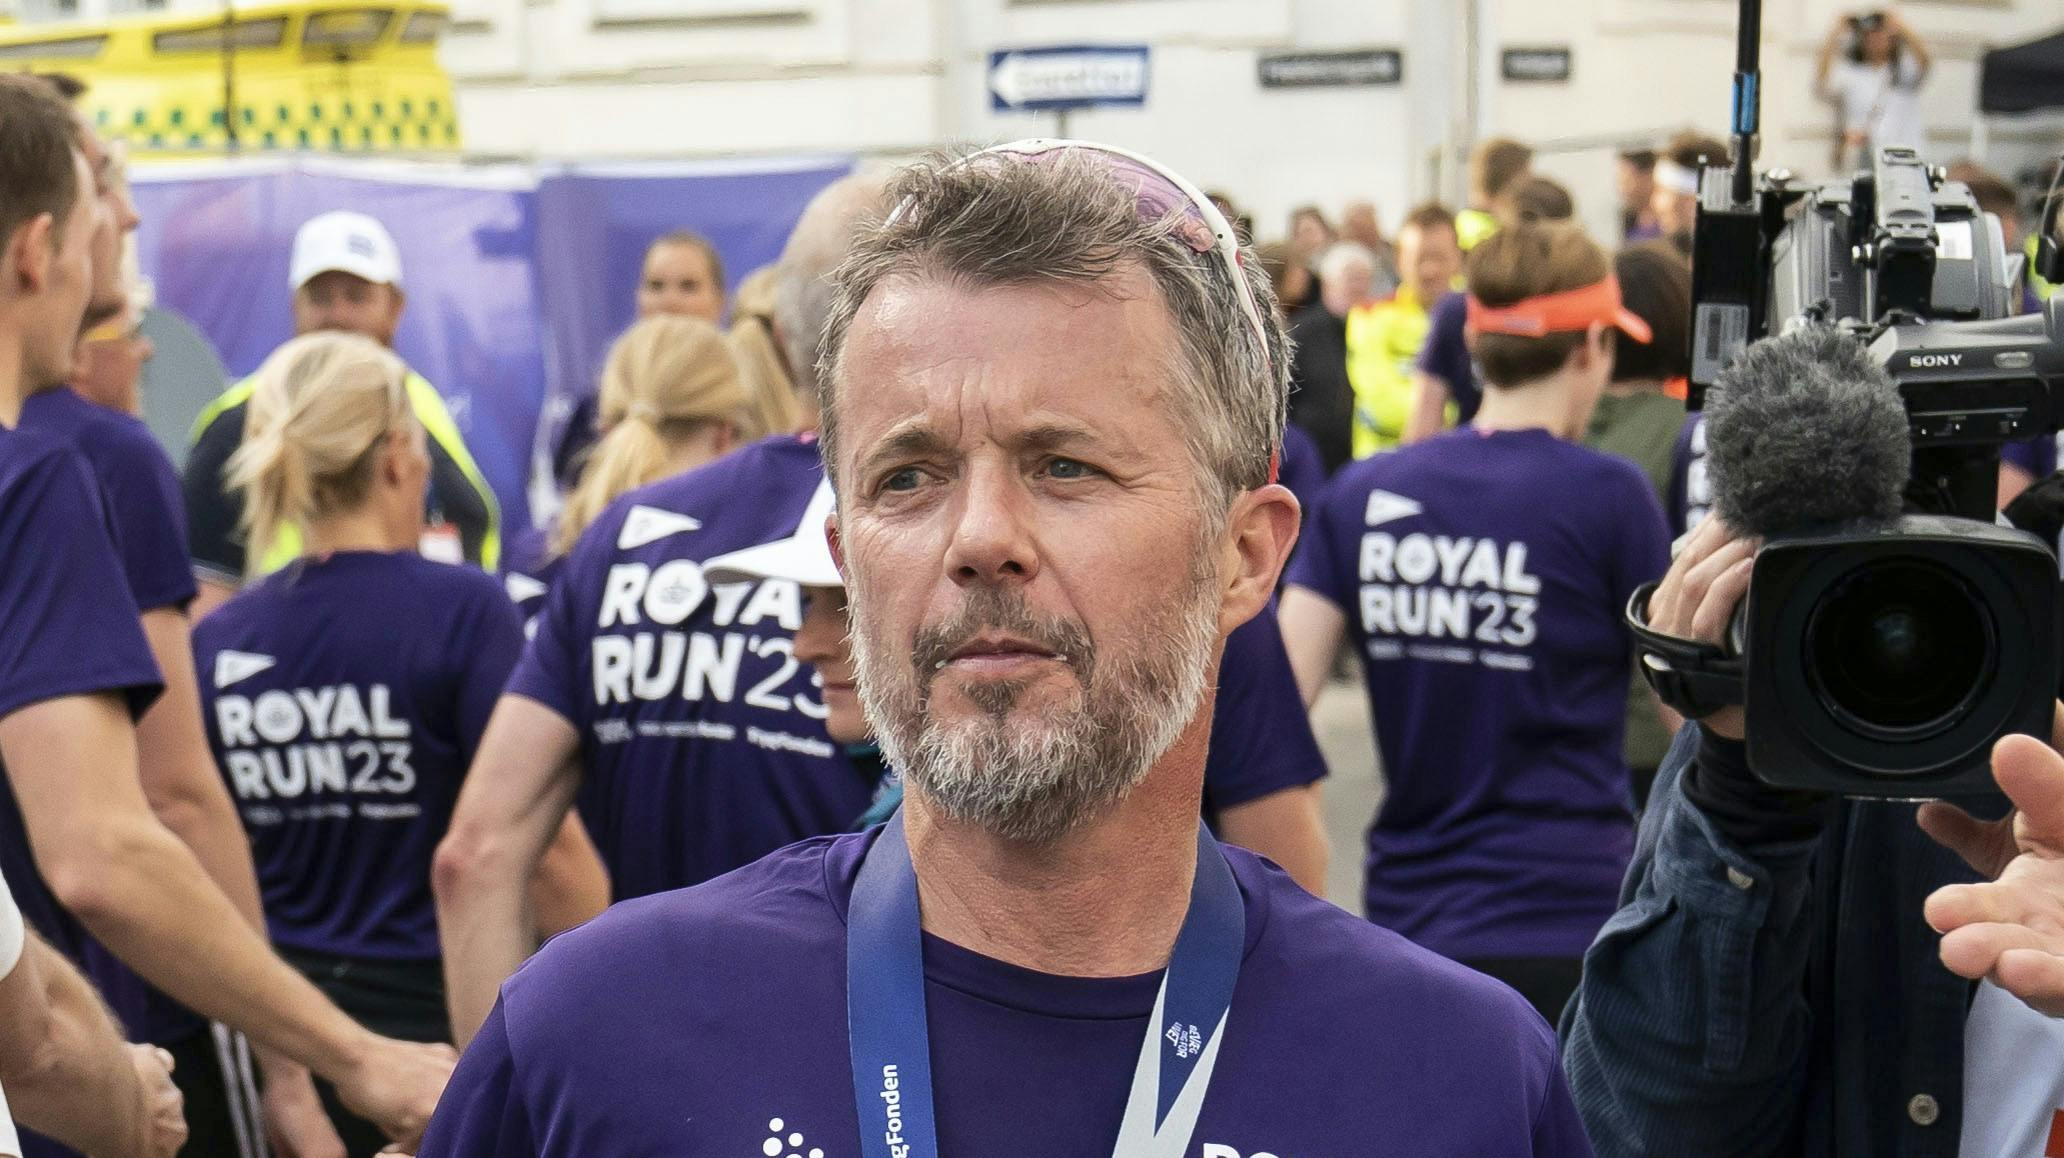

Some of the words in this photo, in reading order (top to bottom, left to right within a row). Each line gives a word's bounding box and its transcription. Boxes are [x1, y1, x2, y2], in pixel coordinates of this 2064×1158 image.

[1909, 353, 1963, 368] SONY
[598, 558, 802, 631] ROYA
[1359, 531, 1542, 595] ROYAL
[214, 683, 411, 748] ROYAL
[1176, 1041, 1188, 1058] FOR
